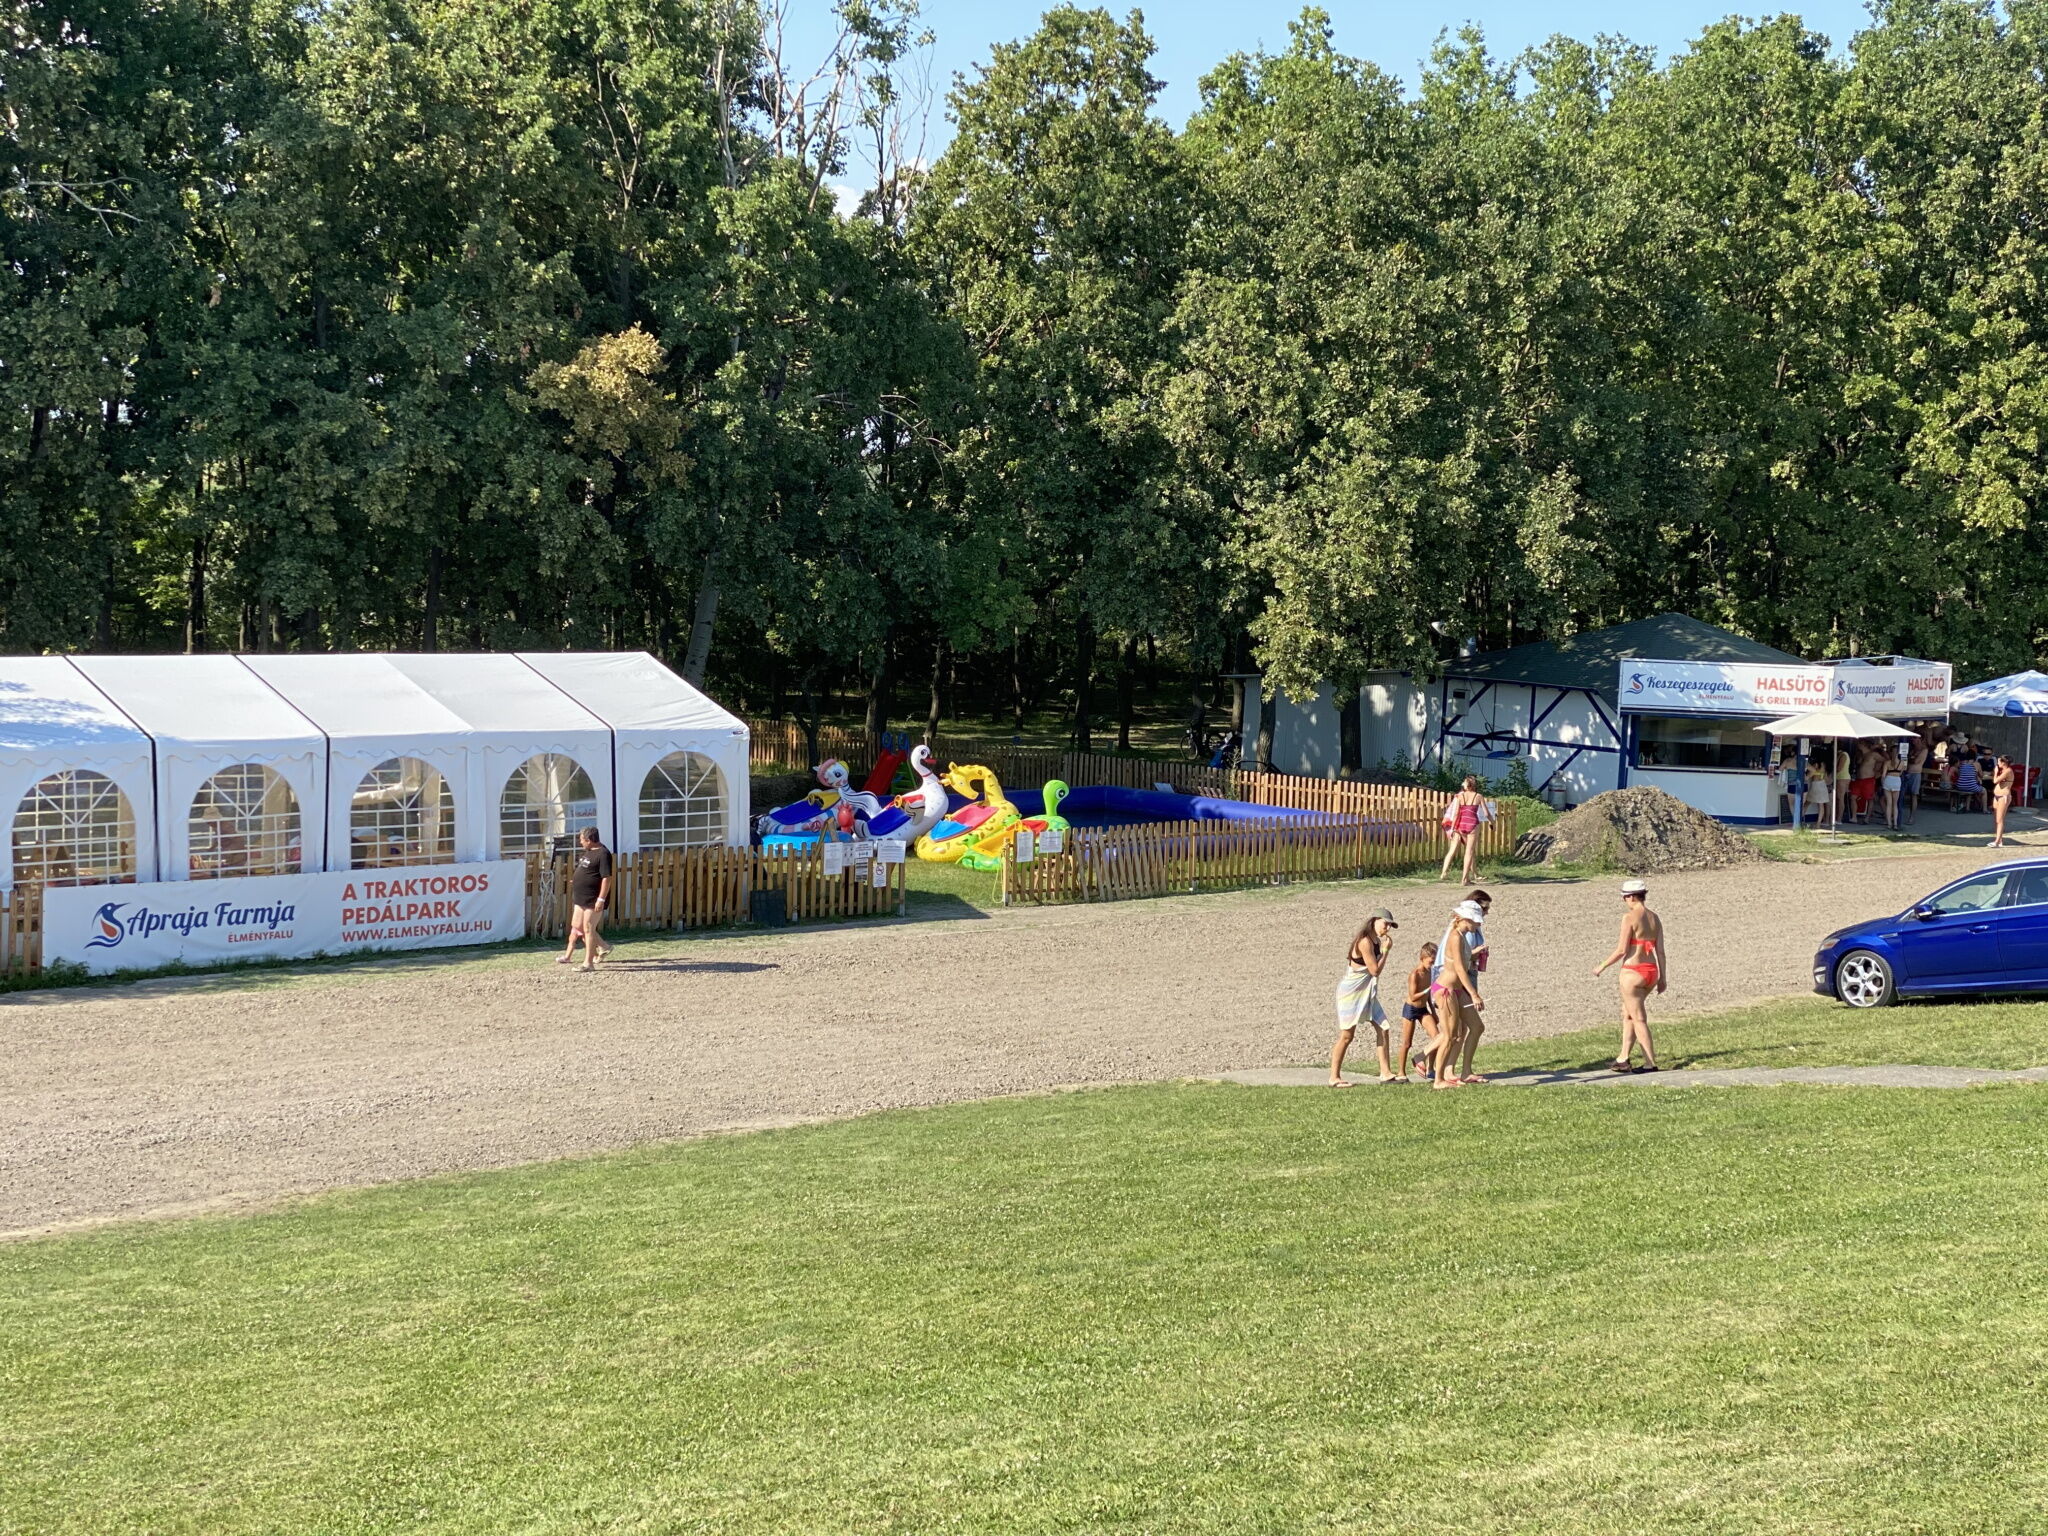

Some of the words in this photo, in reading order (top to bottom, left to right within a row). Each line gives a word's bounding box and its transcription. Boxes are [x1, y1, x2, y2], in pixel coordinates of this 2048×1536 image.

[1757, 674, 1826, 692] HALSÜTŐ
[1907, 673, 1945, 691] HALSÜTŐ
[1754, 693, 1764, 704] ÉS
[1767, 696, 1791, 705] GRILL
[1793, 697, 1826, 706] TERASZ
[341, 883, 357, 901] A
[364, 873, 489, 899] TRAKTOROS
[126, 905, 209, 938] Apraja
[214, 900, 296, 930] Farmja
[342, 899, 462, 926] PEDÁLPARK
[227, 930, 294, 943] ÉLMÉNYFALU
[342, 920, 493, 943] WWW.ELMENYFALU.HU
